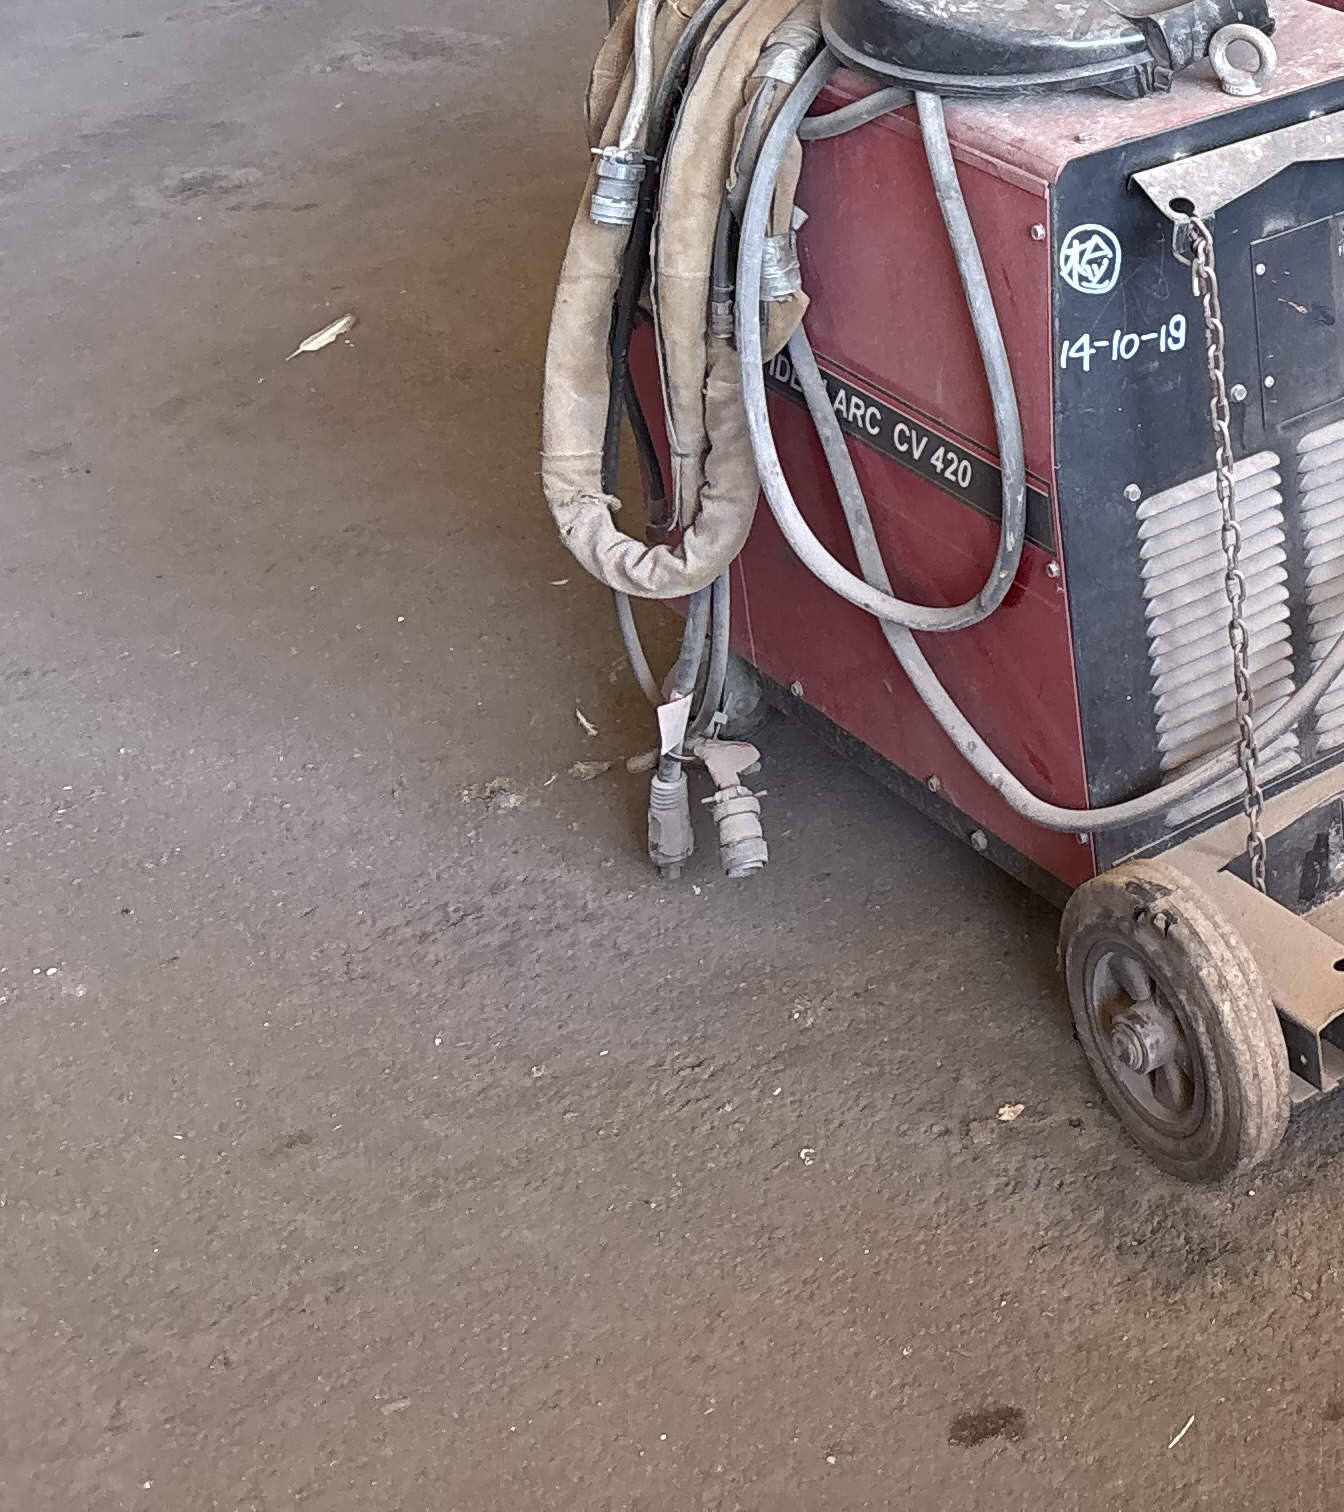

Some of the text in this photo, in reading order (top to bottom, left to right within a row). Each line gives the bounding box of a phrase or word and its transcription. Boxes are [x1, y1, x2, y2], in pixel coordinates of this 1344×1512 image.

[1059, 313, 1187, 372] 14-10-19
[893, 422, 928, 461] CV
[930, 445, 972, 489] 420
